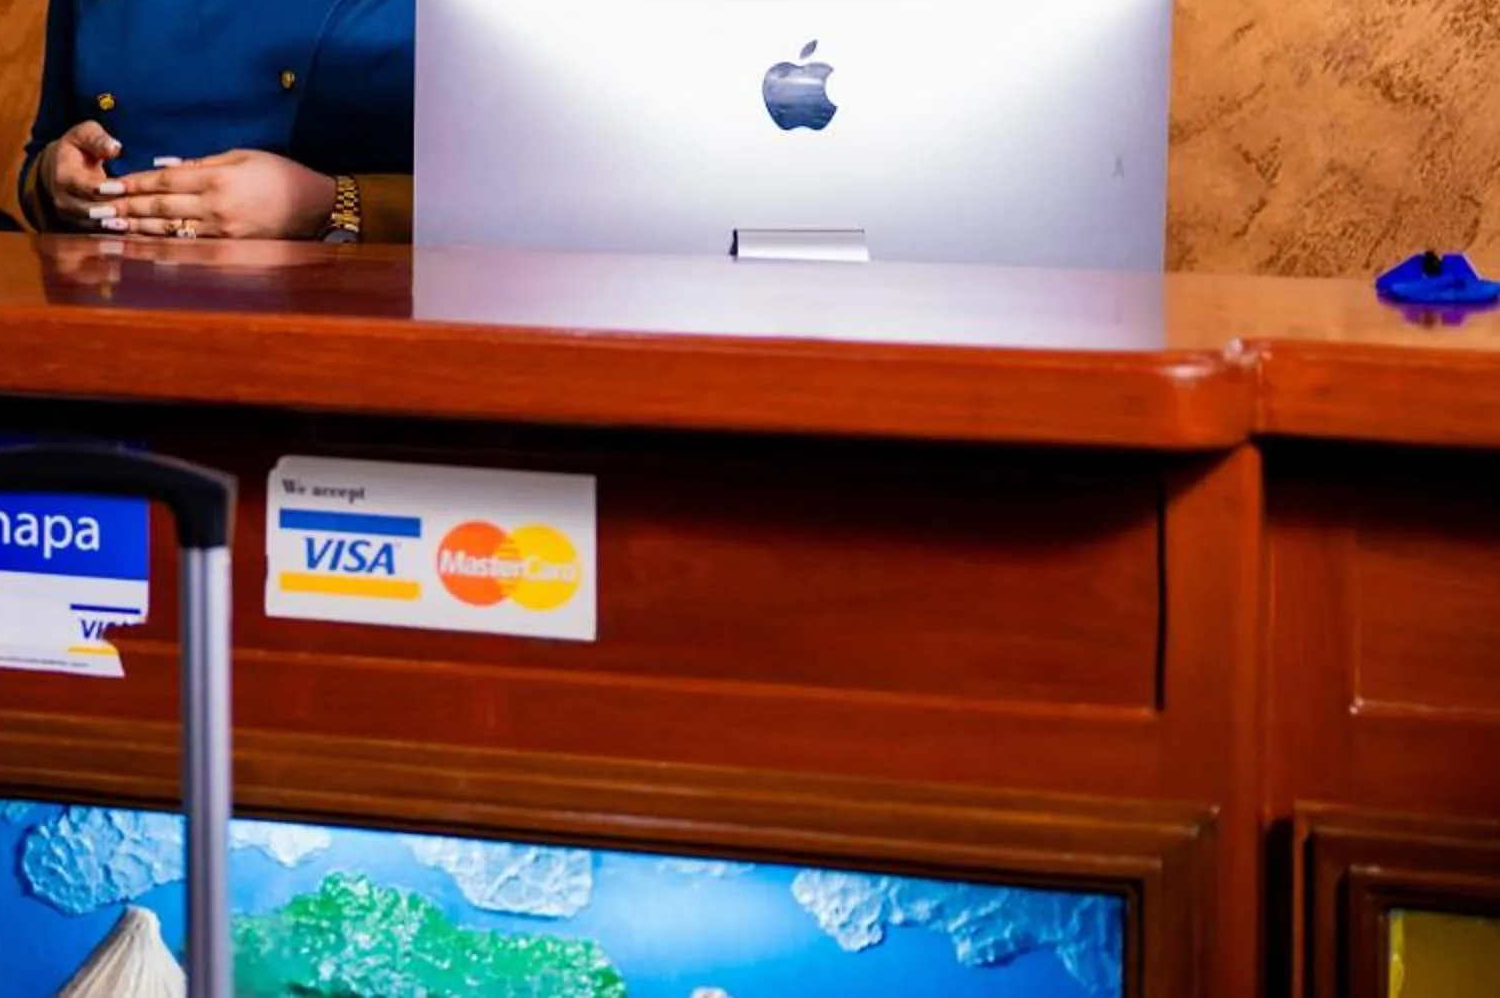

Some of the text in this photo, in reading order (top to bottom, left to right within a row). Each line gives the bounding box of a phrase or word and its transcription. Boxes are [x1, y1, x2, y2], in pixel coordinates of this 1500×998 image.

[282, 478, 366, 504] We accept
[304, 537, 396, 575] VISA
[439, 549, 577, 583] MasterCard
[80, 619, 130, 640] VI
